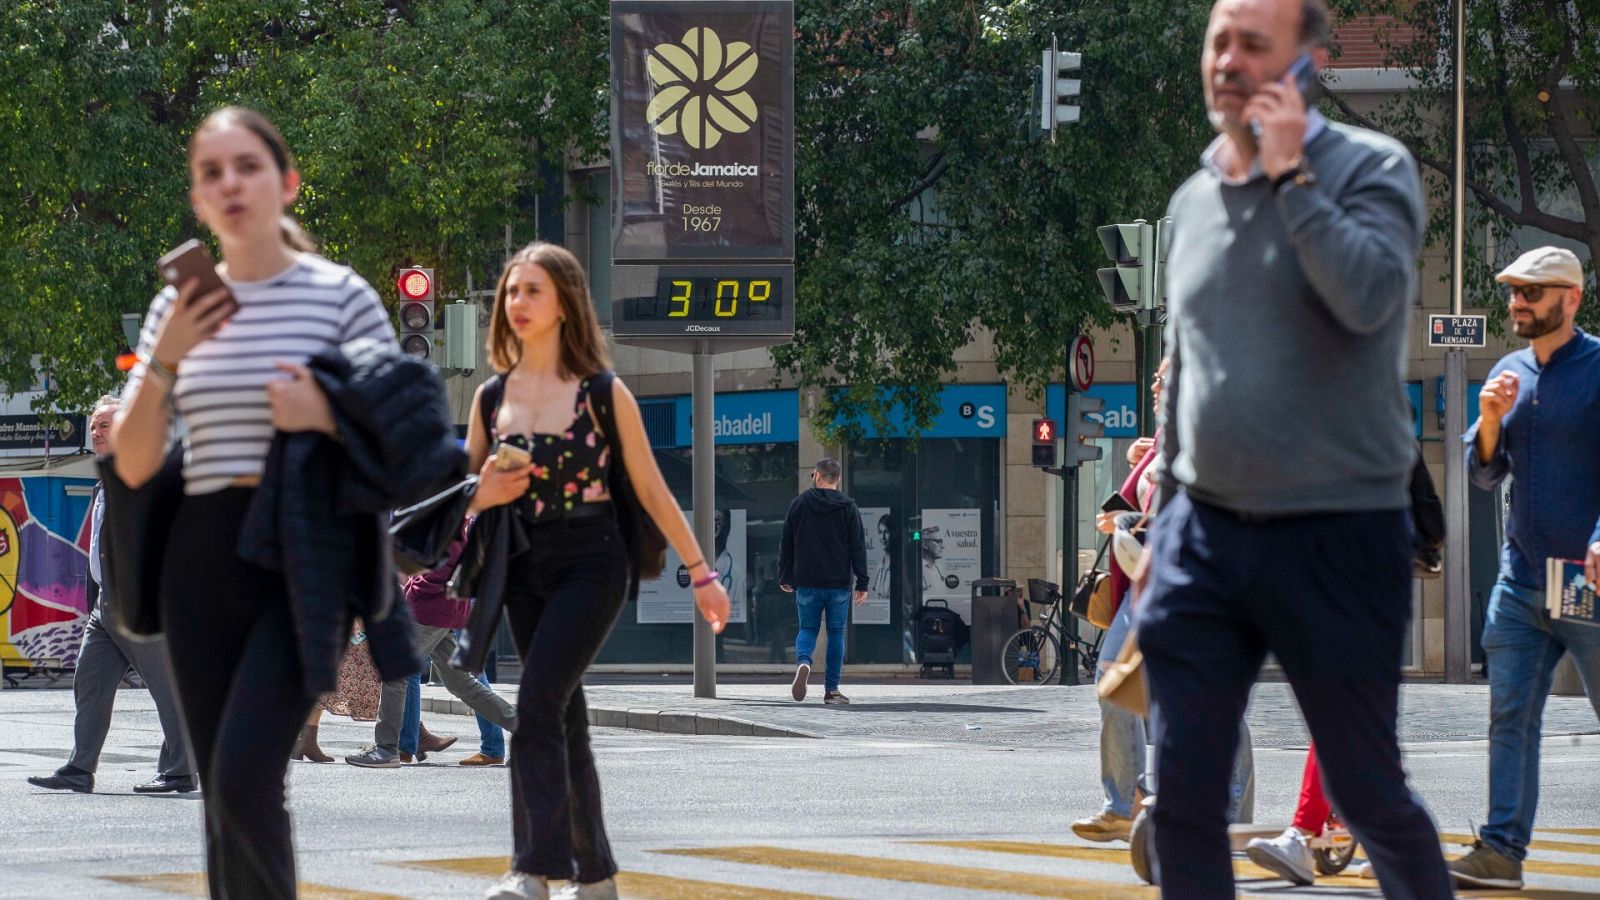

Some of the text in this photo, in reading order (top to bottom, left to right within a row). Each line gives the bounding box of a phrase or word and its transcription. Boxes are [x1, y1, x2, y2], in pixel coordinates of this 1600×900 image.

[689, 180, 701, 188] Tés
[702, 180, 715, 188] del
[716, 180, 744, 188] Mundo
[683, 203, 722, 215] Desde
[682, 216, 721, 232] 1967
[1452, 318, 1478, 327] PLAZA
[1441, 336, 1474, 344] FUENSANTA
[0, 423, 14, 432] ofres
[15, 422, 47, 431] Mannek
[714, 412, 771, 436] abadell
[951, 530, 978, 538] vuestra
[956, 538, 978, 548] salud.
